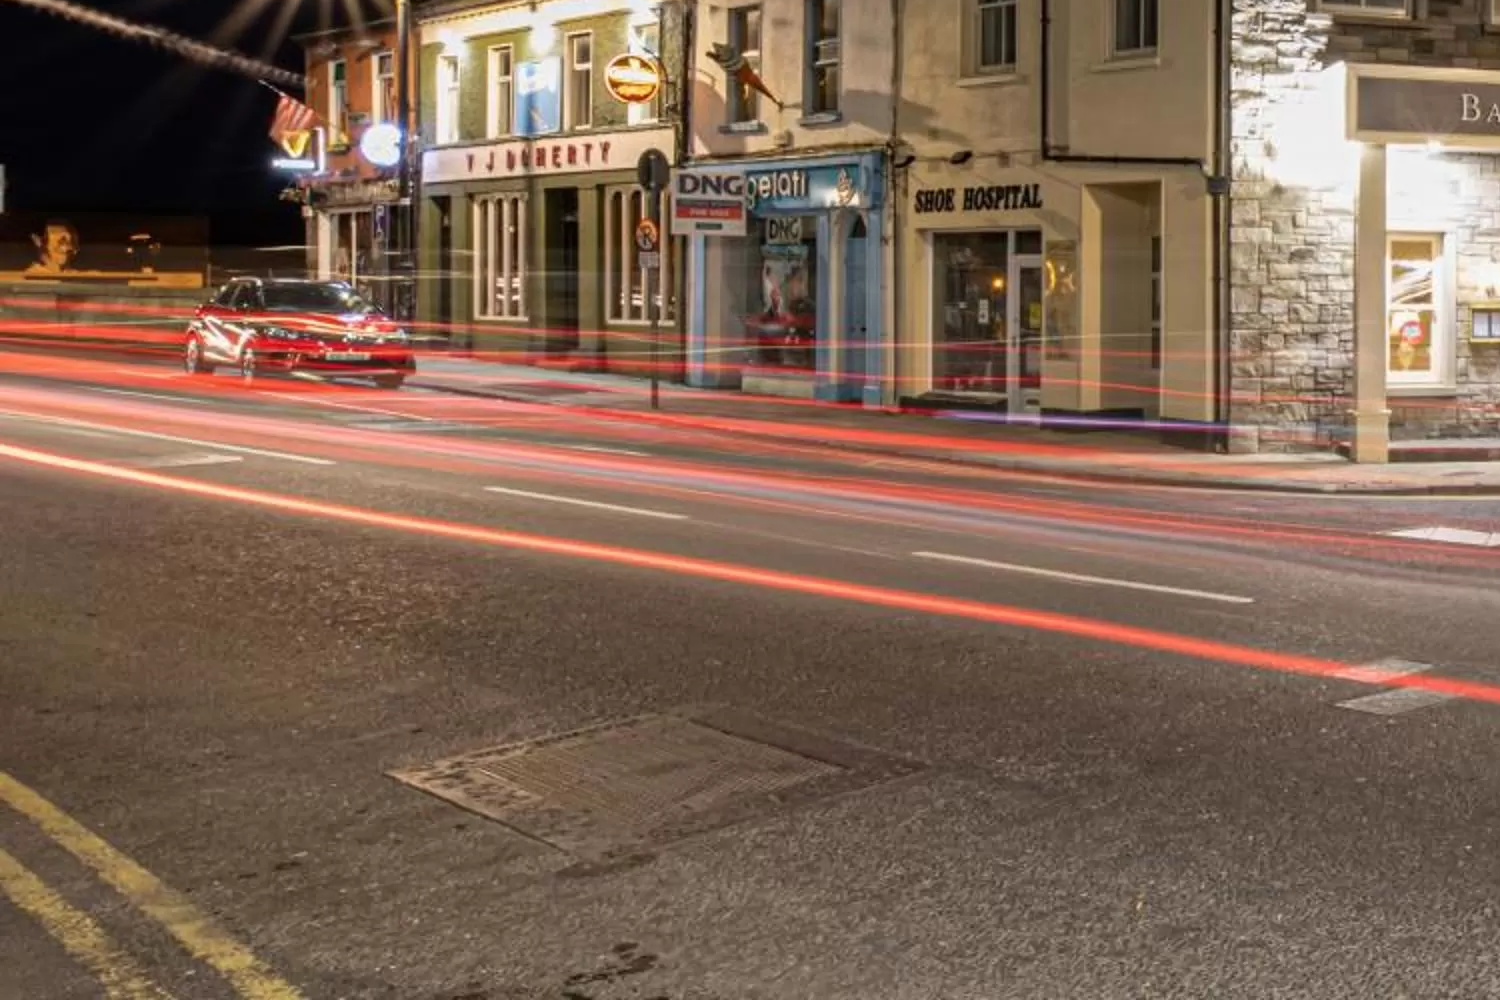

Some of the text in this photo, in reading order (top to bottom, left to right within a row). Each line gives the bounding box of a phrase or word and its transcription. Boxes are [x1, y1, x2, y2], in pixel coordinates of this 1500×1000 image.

[506, 141, 611, 171] DOHERTY
[679, 175, 742, 194] DNG
[746, 168, 808, 209] gelati
[914, 183, 1044, 213] SHOE HOSPITAL
[769, 218, 800, 240] DNG
